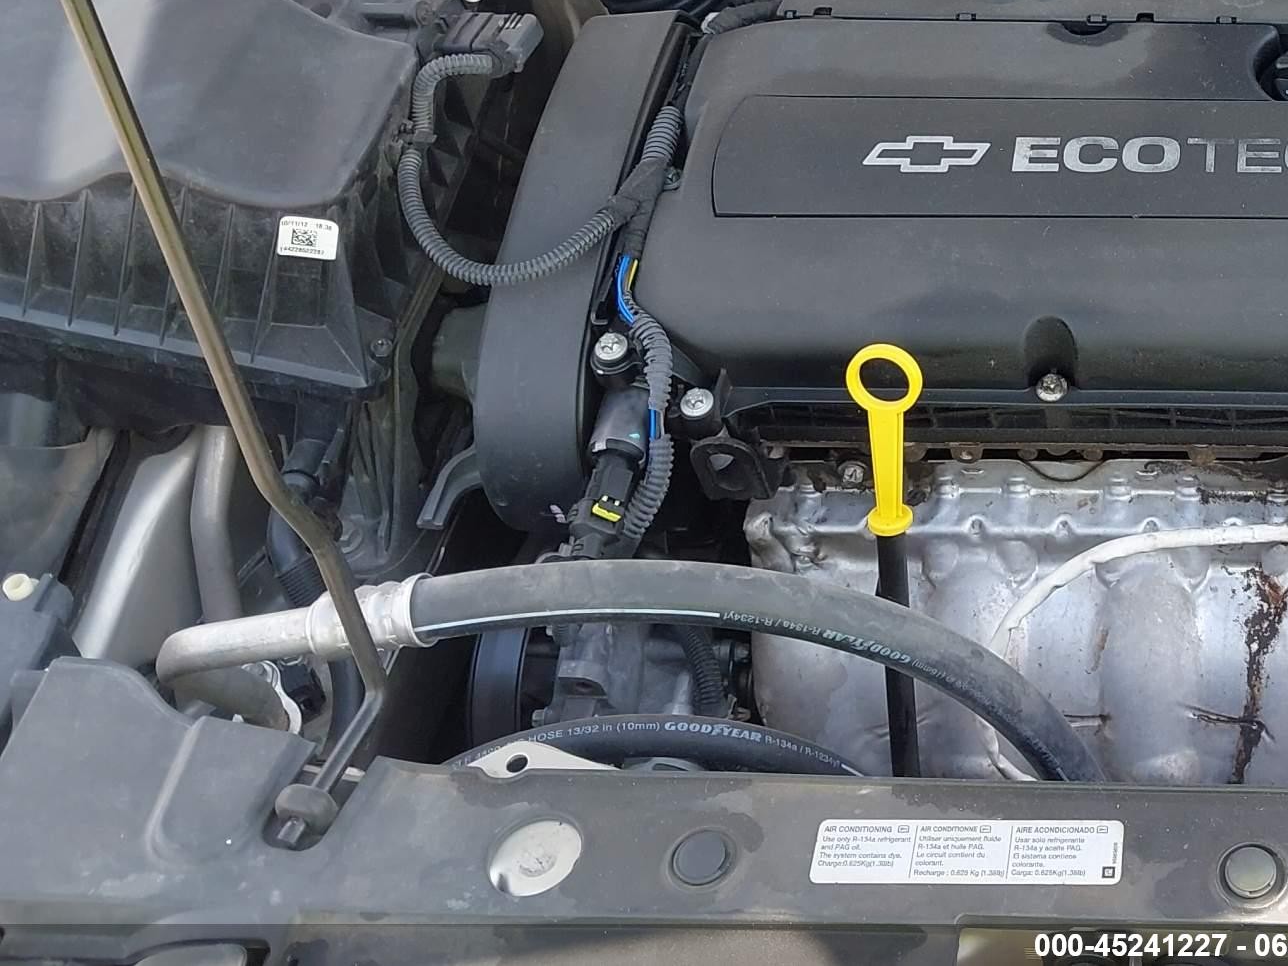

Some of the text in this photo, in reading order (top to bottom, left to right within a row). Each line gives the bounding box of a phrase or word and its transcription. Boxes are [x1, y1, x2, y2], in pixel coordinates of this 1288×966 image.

[723, 610, 773, 627] R-1234yf
[783, 620, 820, 636] R-134a
[822, 628, 911, 663] GOODYEAR
[528, 730, 564, 743] HOSE
[567, 725, 599, 737] 13/32
[602, 722, 612, 732] in
[616, 722, 660, 732] (10mm)
[664, 721, 762, 742] GOODYEAR
[765, 736, 798, 752] R-134a
